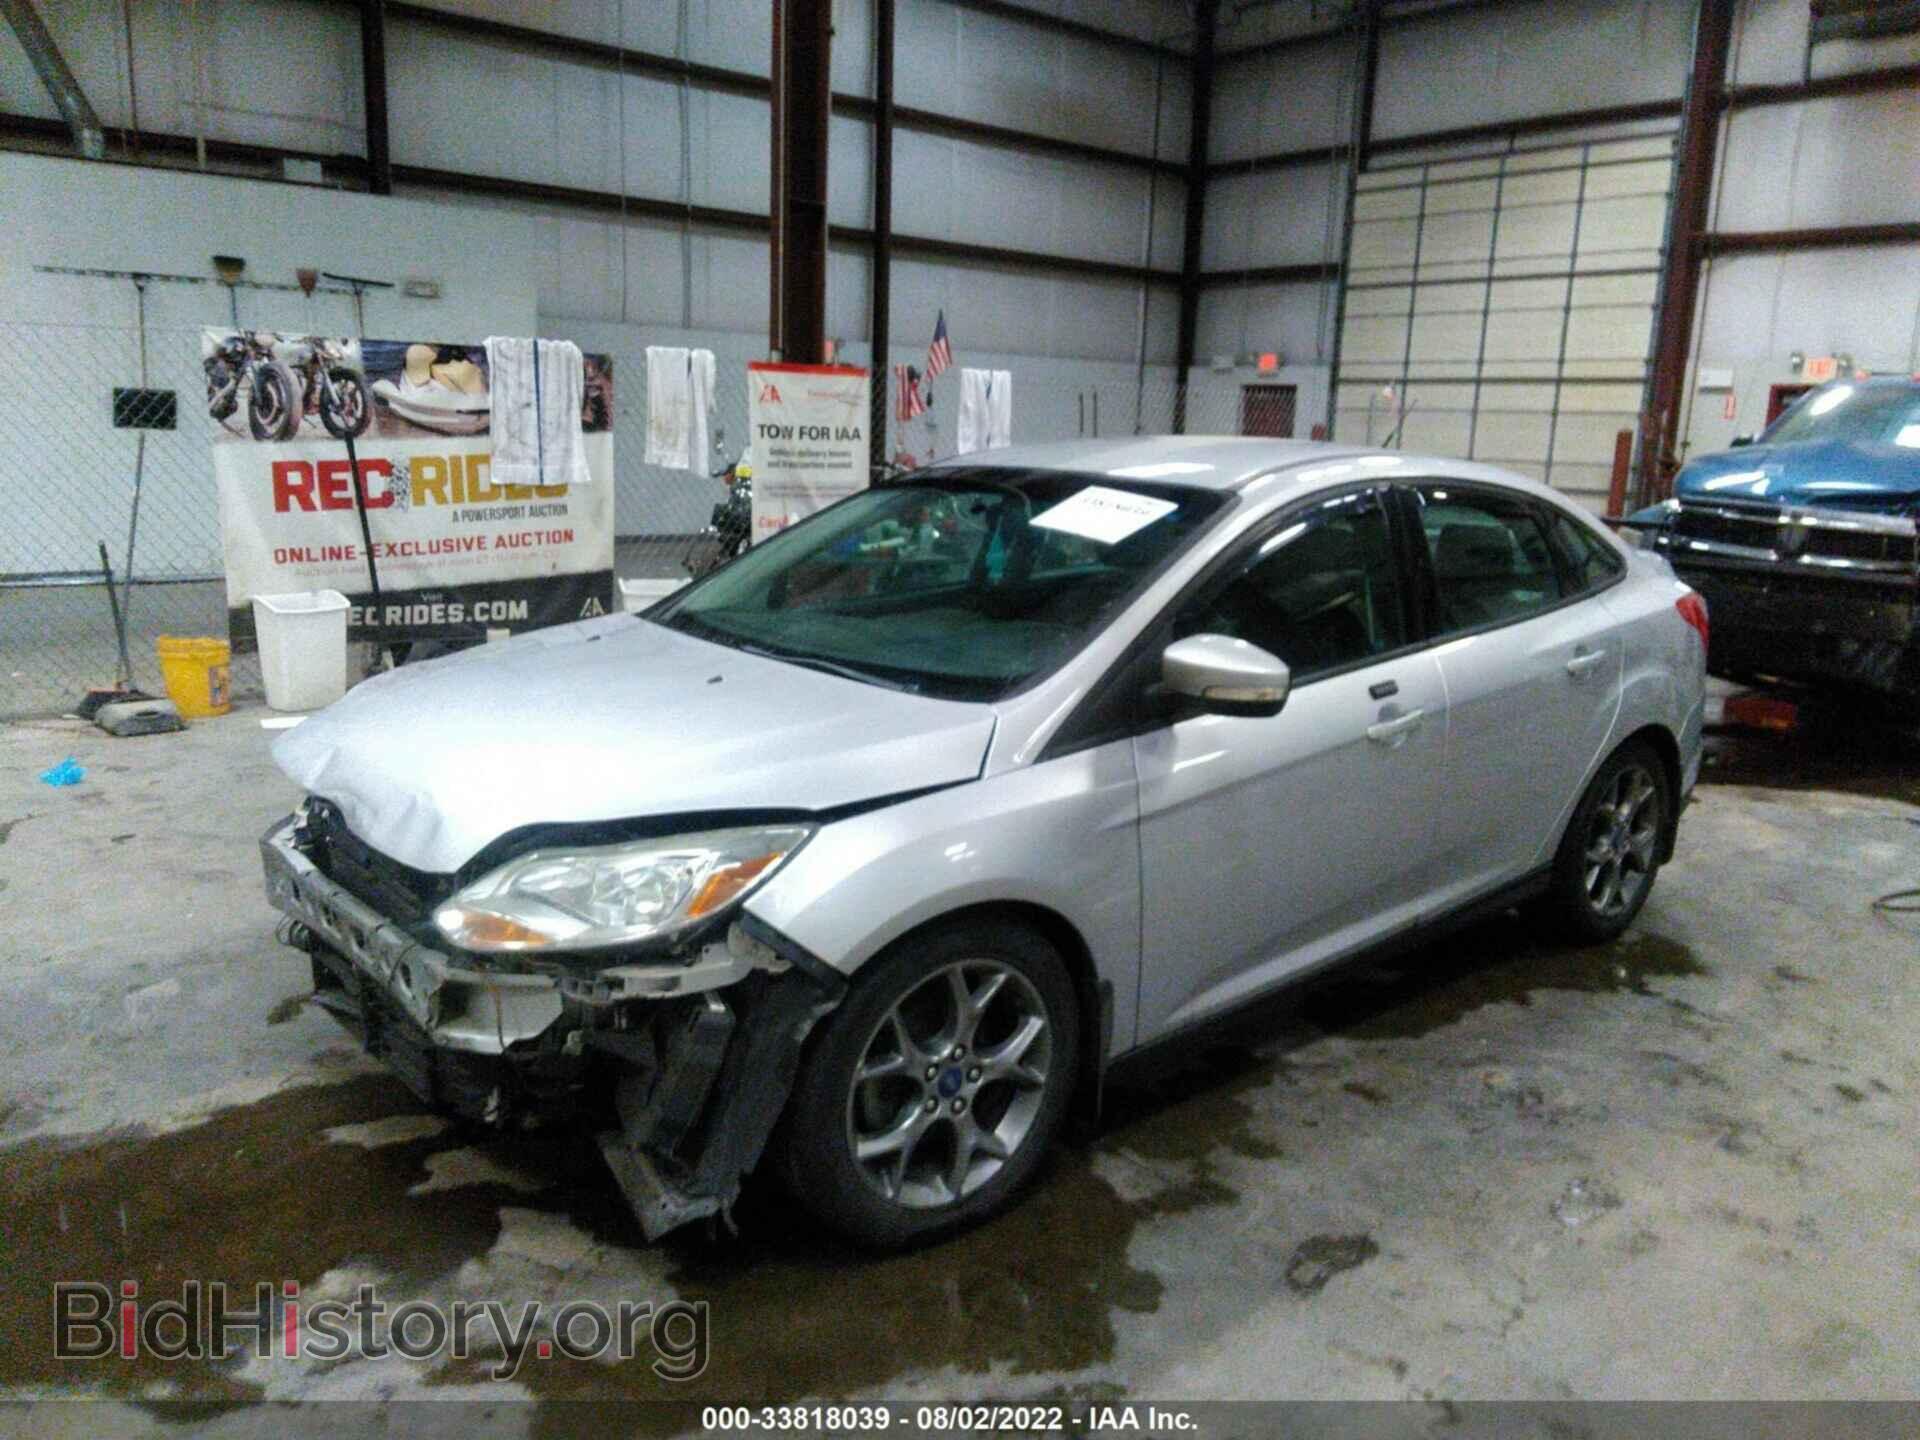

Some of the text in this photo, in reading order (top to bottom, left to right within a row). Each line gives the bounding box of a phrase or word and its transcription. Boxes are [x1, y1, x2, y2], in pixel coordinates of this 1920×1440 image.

[758, 424, 862, 442] TOW FOR IAA
[272, 453, 569, 513] REC RID
[452, 503, 569, 523] A POWERSPORT AUCTION
[494, 528, 575, 550] AUCTION
[345, 599, 529, 626] EC RIDES.COM
